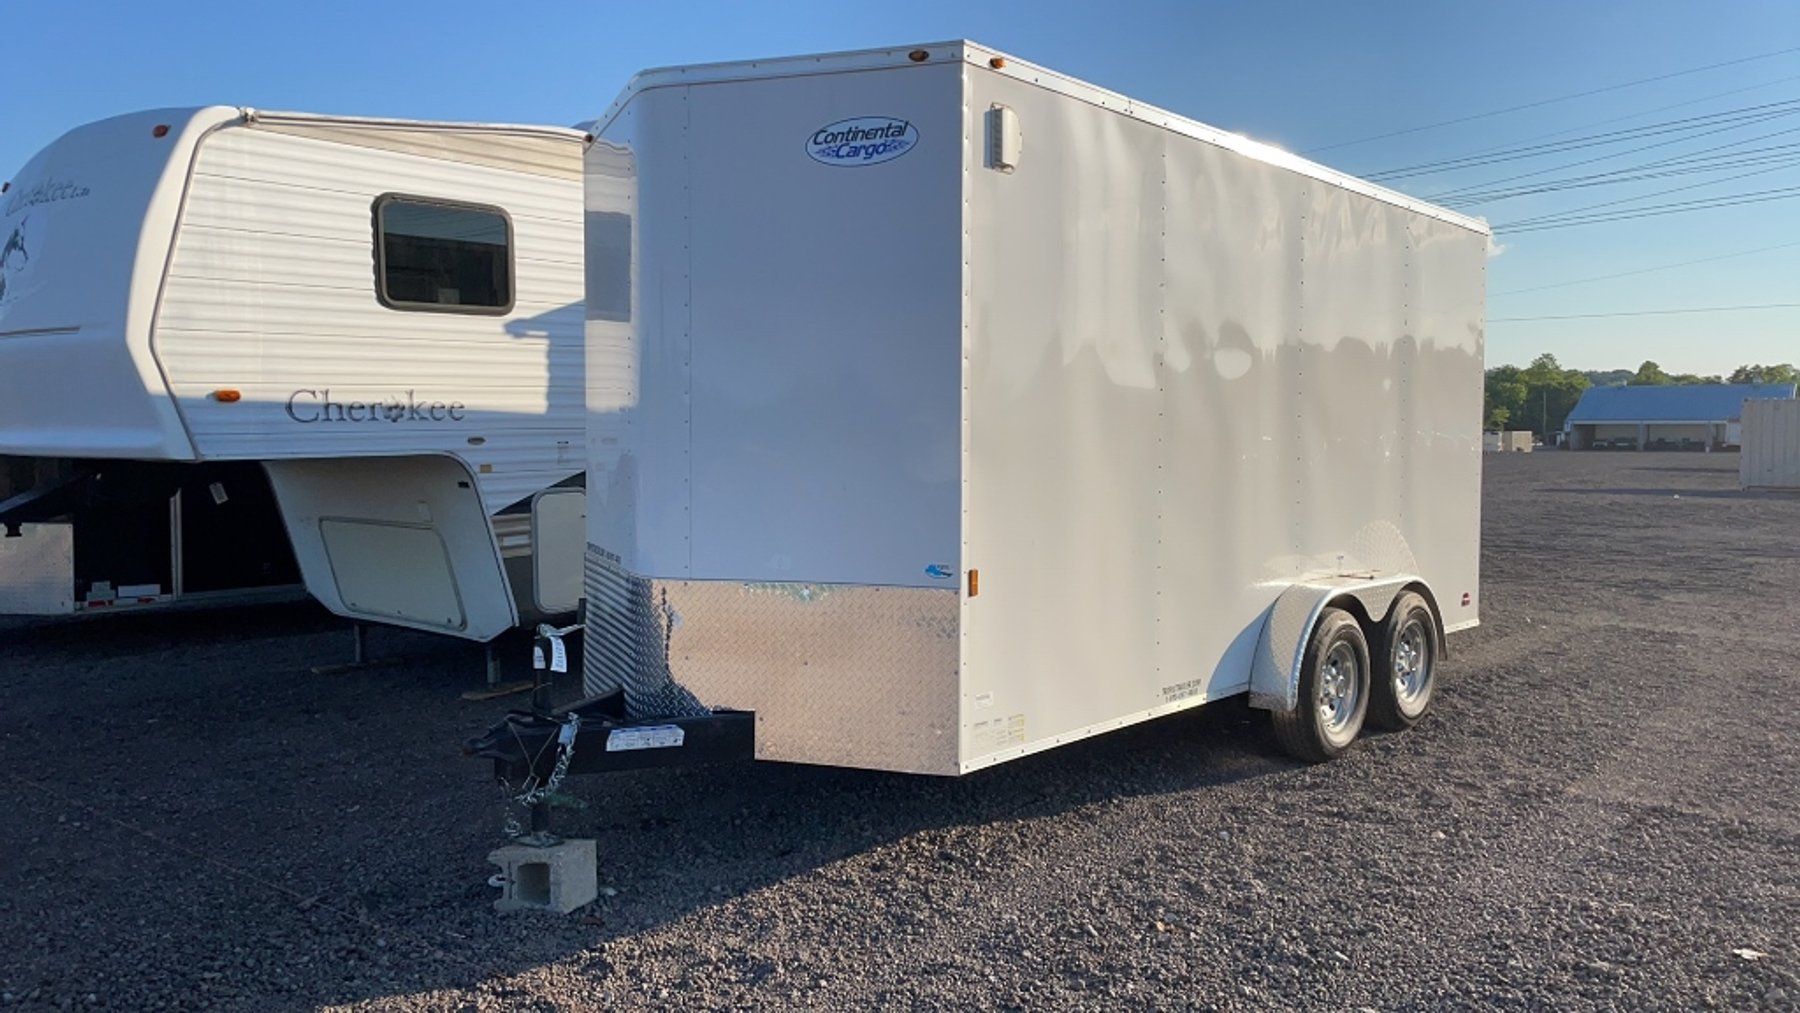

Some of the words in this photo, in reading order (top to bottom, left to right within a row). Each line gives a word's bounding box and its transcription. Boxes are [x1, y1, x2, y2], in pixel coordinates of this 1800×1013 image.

[813, 121, 909, 145] Continental
[835, 142, 887, 160] Cargo
[285, 388, 465, 423] Cherokee
